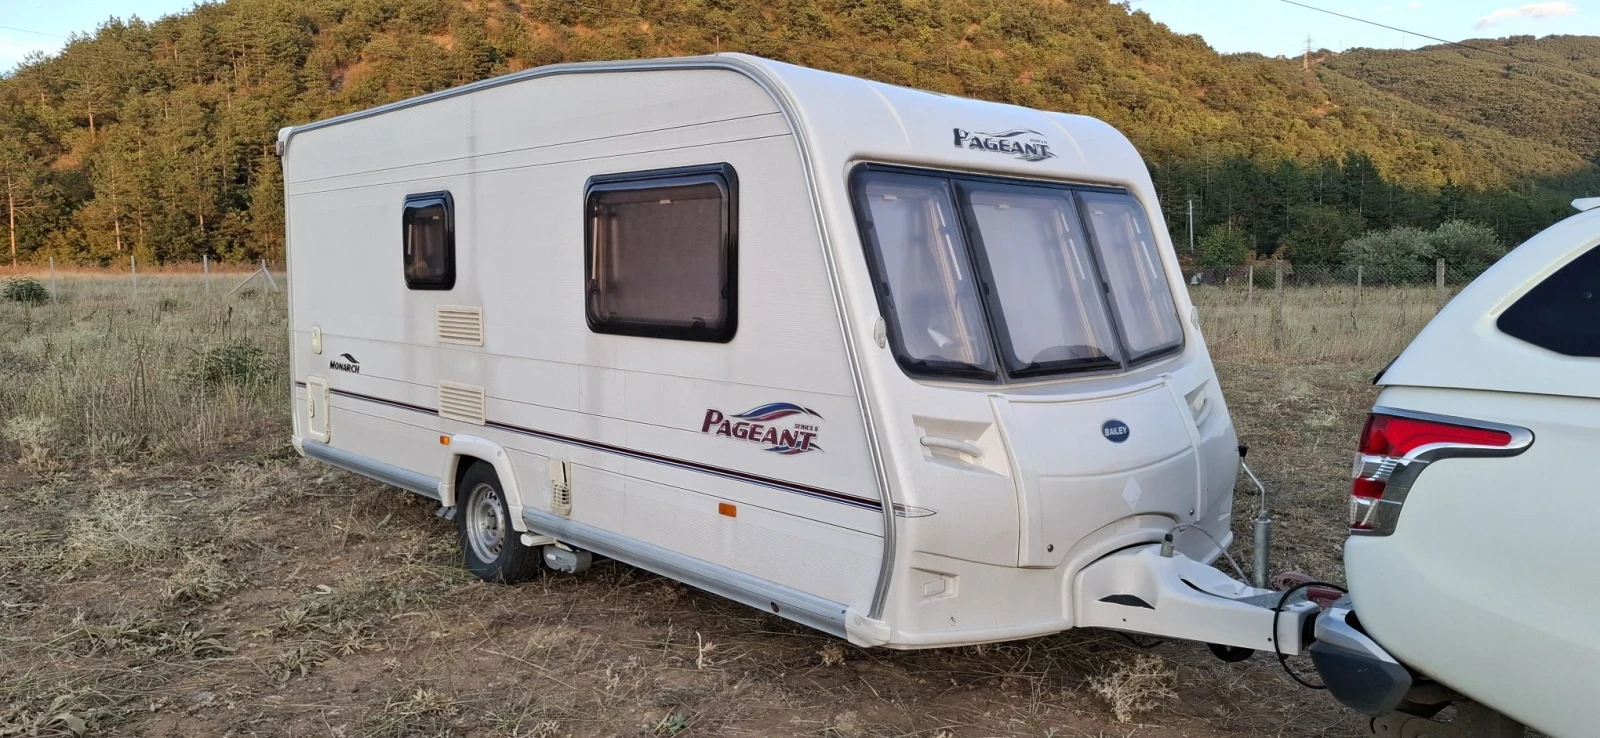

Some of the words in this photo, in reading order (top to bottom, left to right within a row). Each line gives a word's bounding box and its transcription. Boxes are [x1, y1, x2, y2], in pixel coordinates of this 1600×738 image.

[953, 128, 1050, 157] PAGEANT
[329, 360, 360, 374] MONARCH
[701, 408, 817, 451] PAGEANT
[1104, 426, 1127, 436] BAILEY
